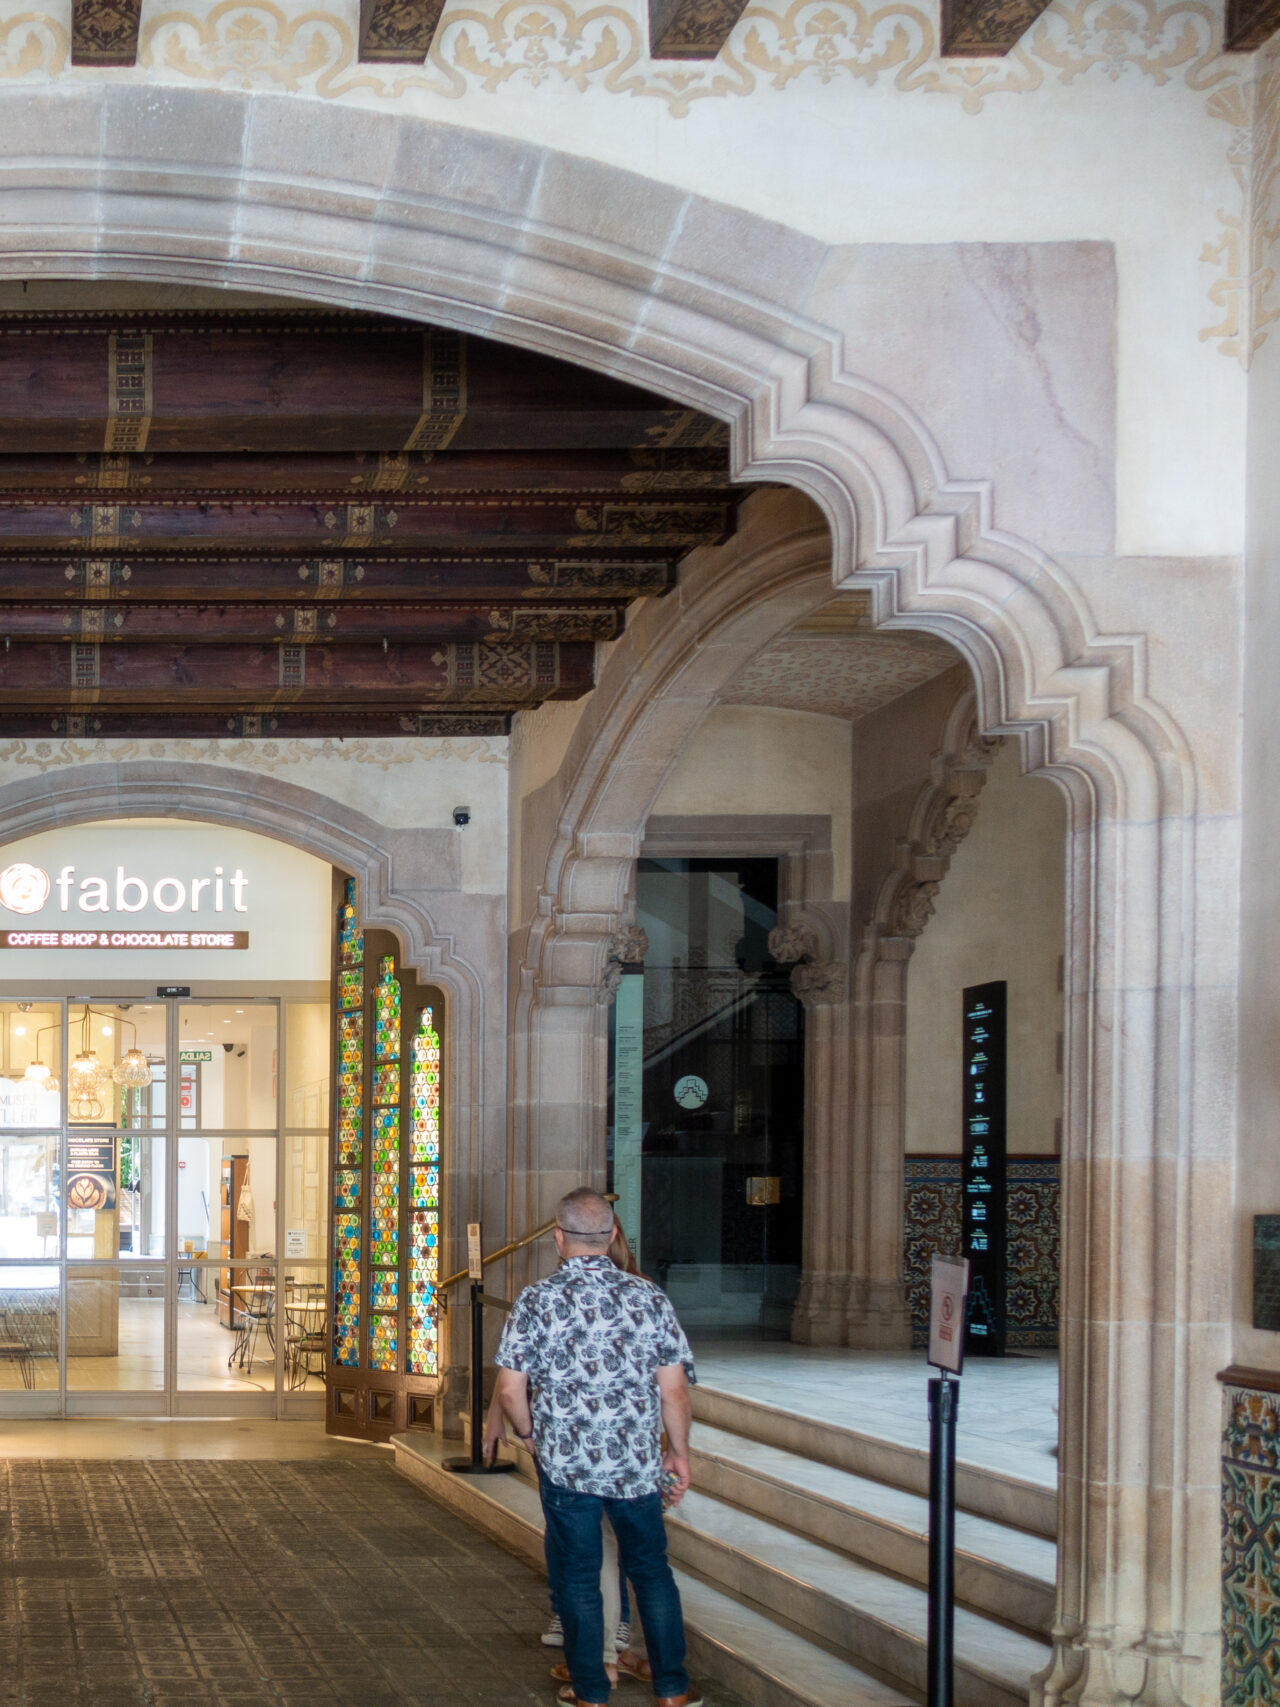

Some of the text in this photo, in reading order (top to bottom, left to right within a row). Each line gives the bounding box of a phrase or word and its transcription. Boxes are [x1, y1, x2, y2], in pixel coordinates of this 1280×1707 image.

[55, 865, 249, 913] faborit
[8, 933, 235, 947] COFFEE SHOP & CHOCOLATE STORE
